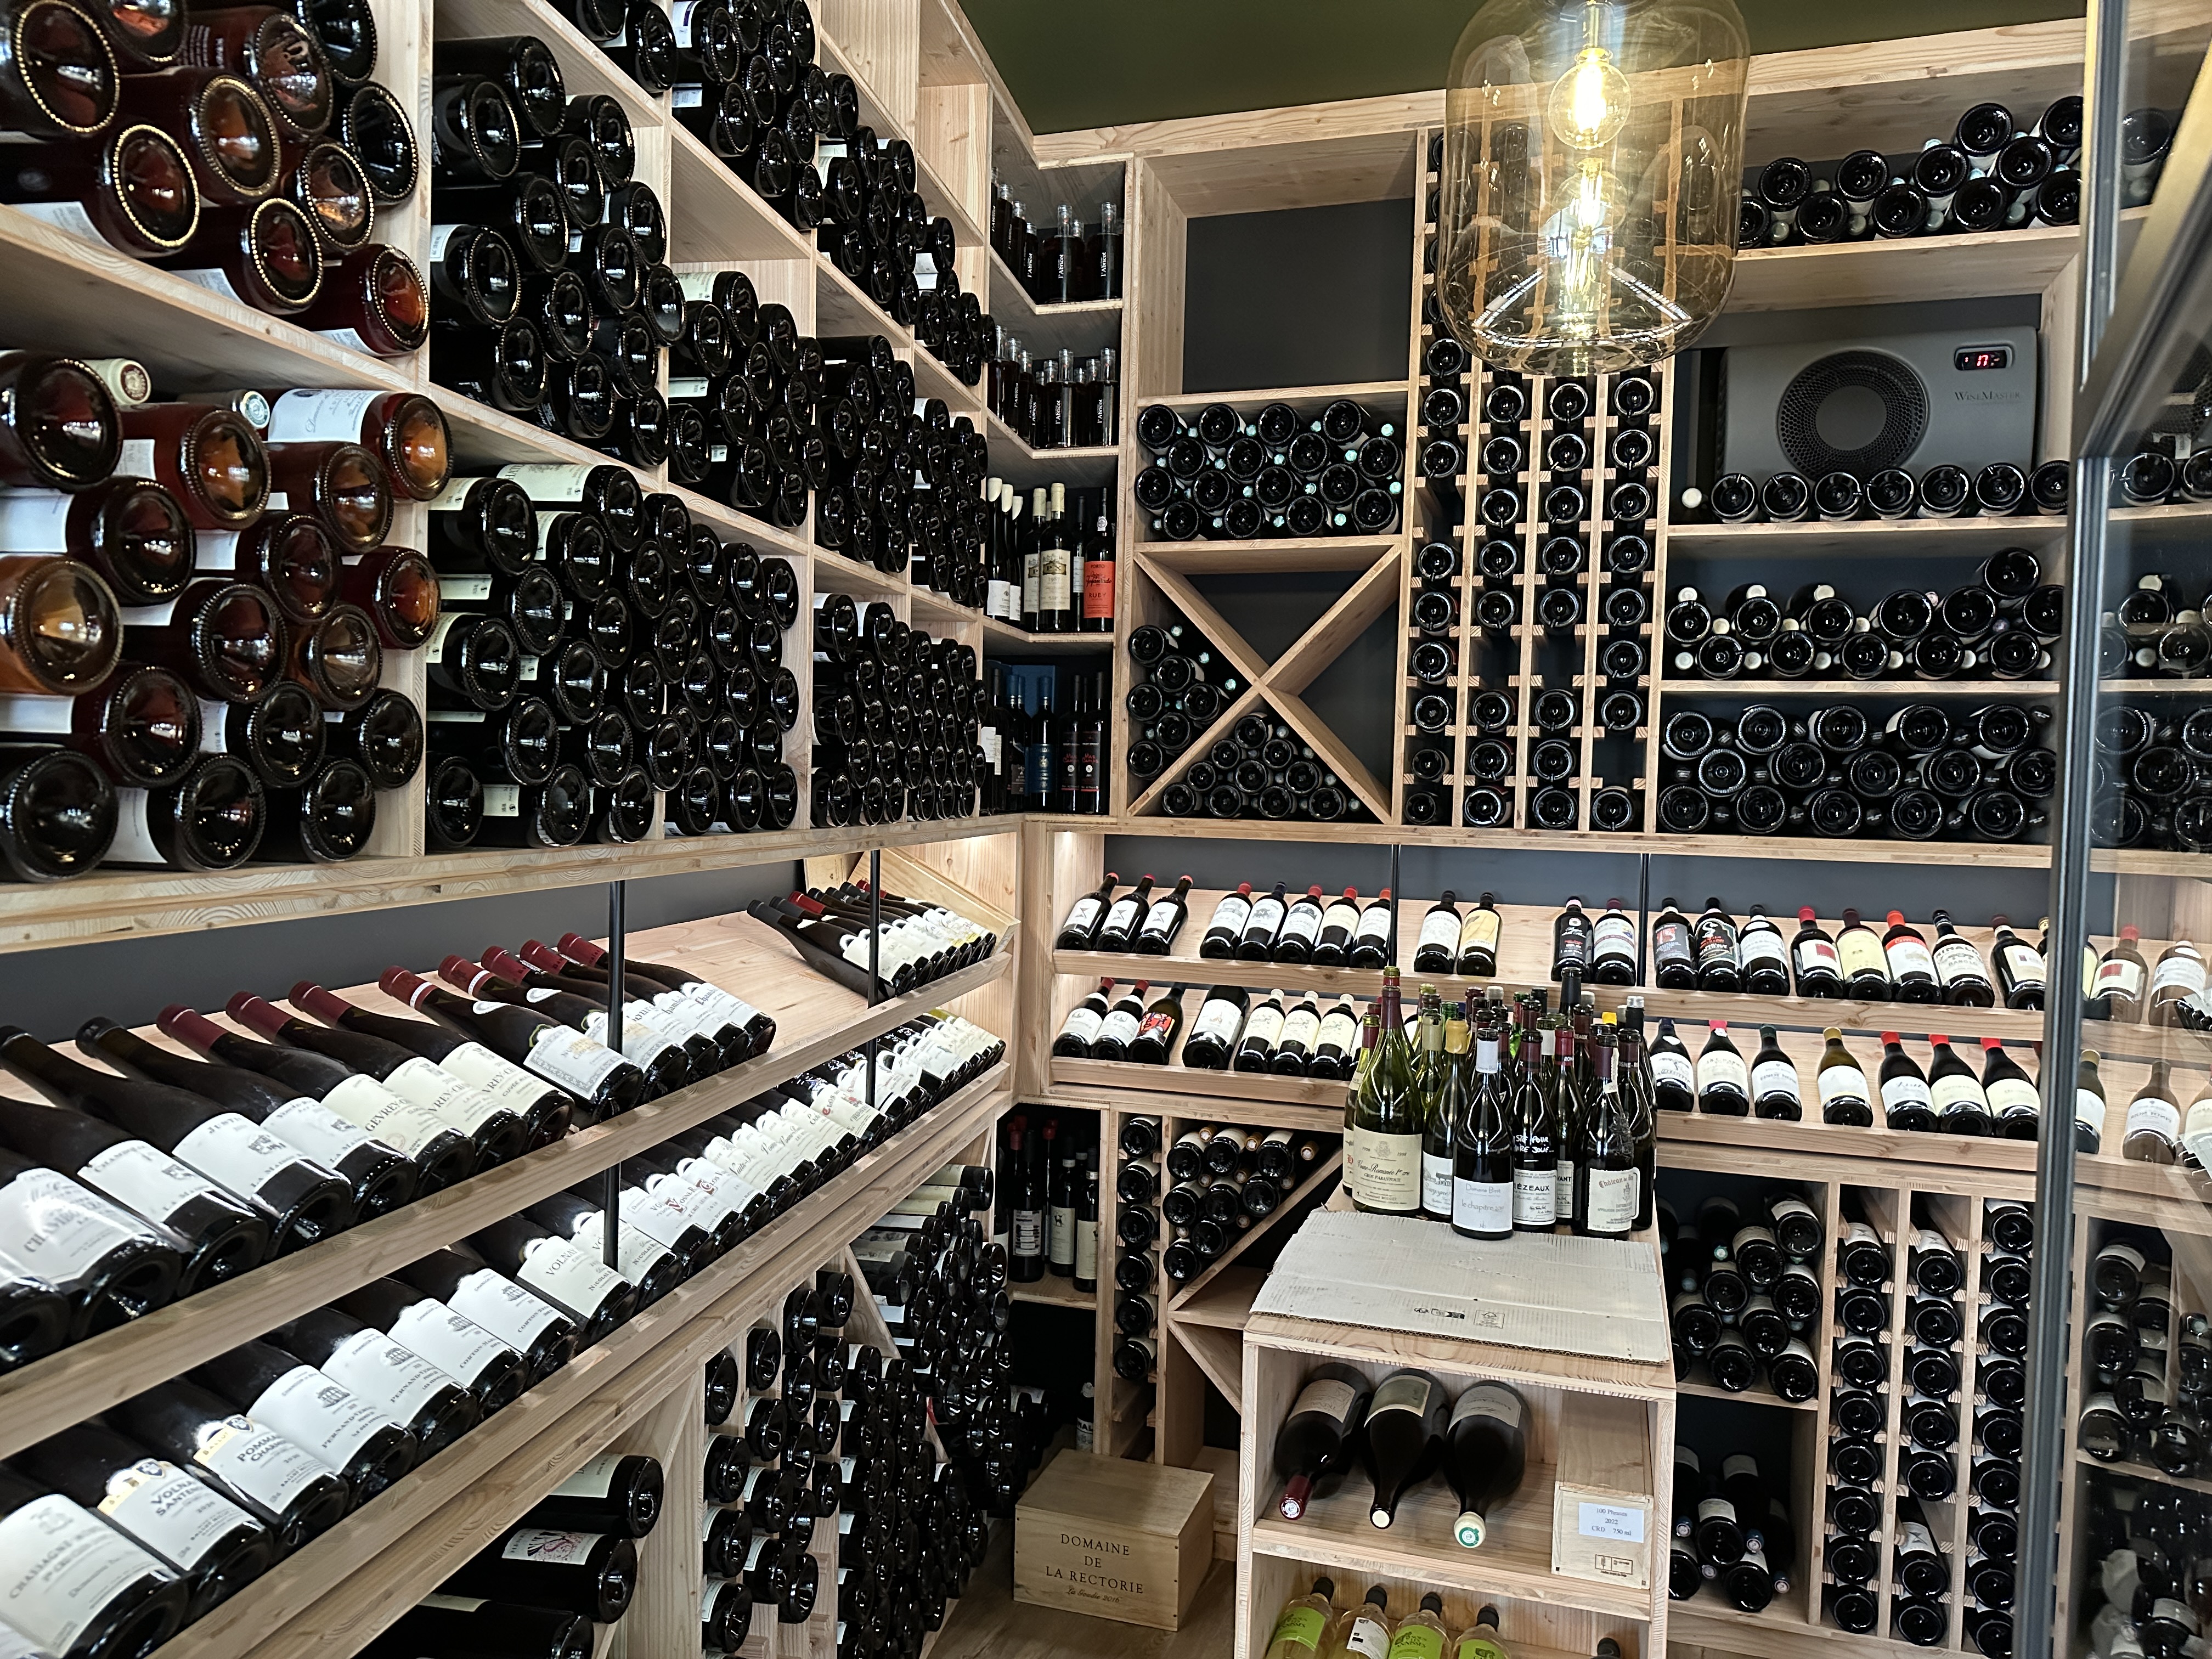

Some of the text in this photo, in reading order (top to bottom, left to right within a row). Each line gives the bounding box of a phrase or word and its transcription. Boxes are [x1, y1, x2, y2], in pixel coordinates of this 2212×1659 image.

[1060, 1533, 1131, 1556] DOMAINE
[1084, 1555, 1102, 1568] DE
[1046, 1566, 1144, 1594] LA RECTORIE
